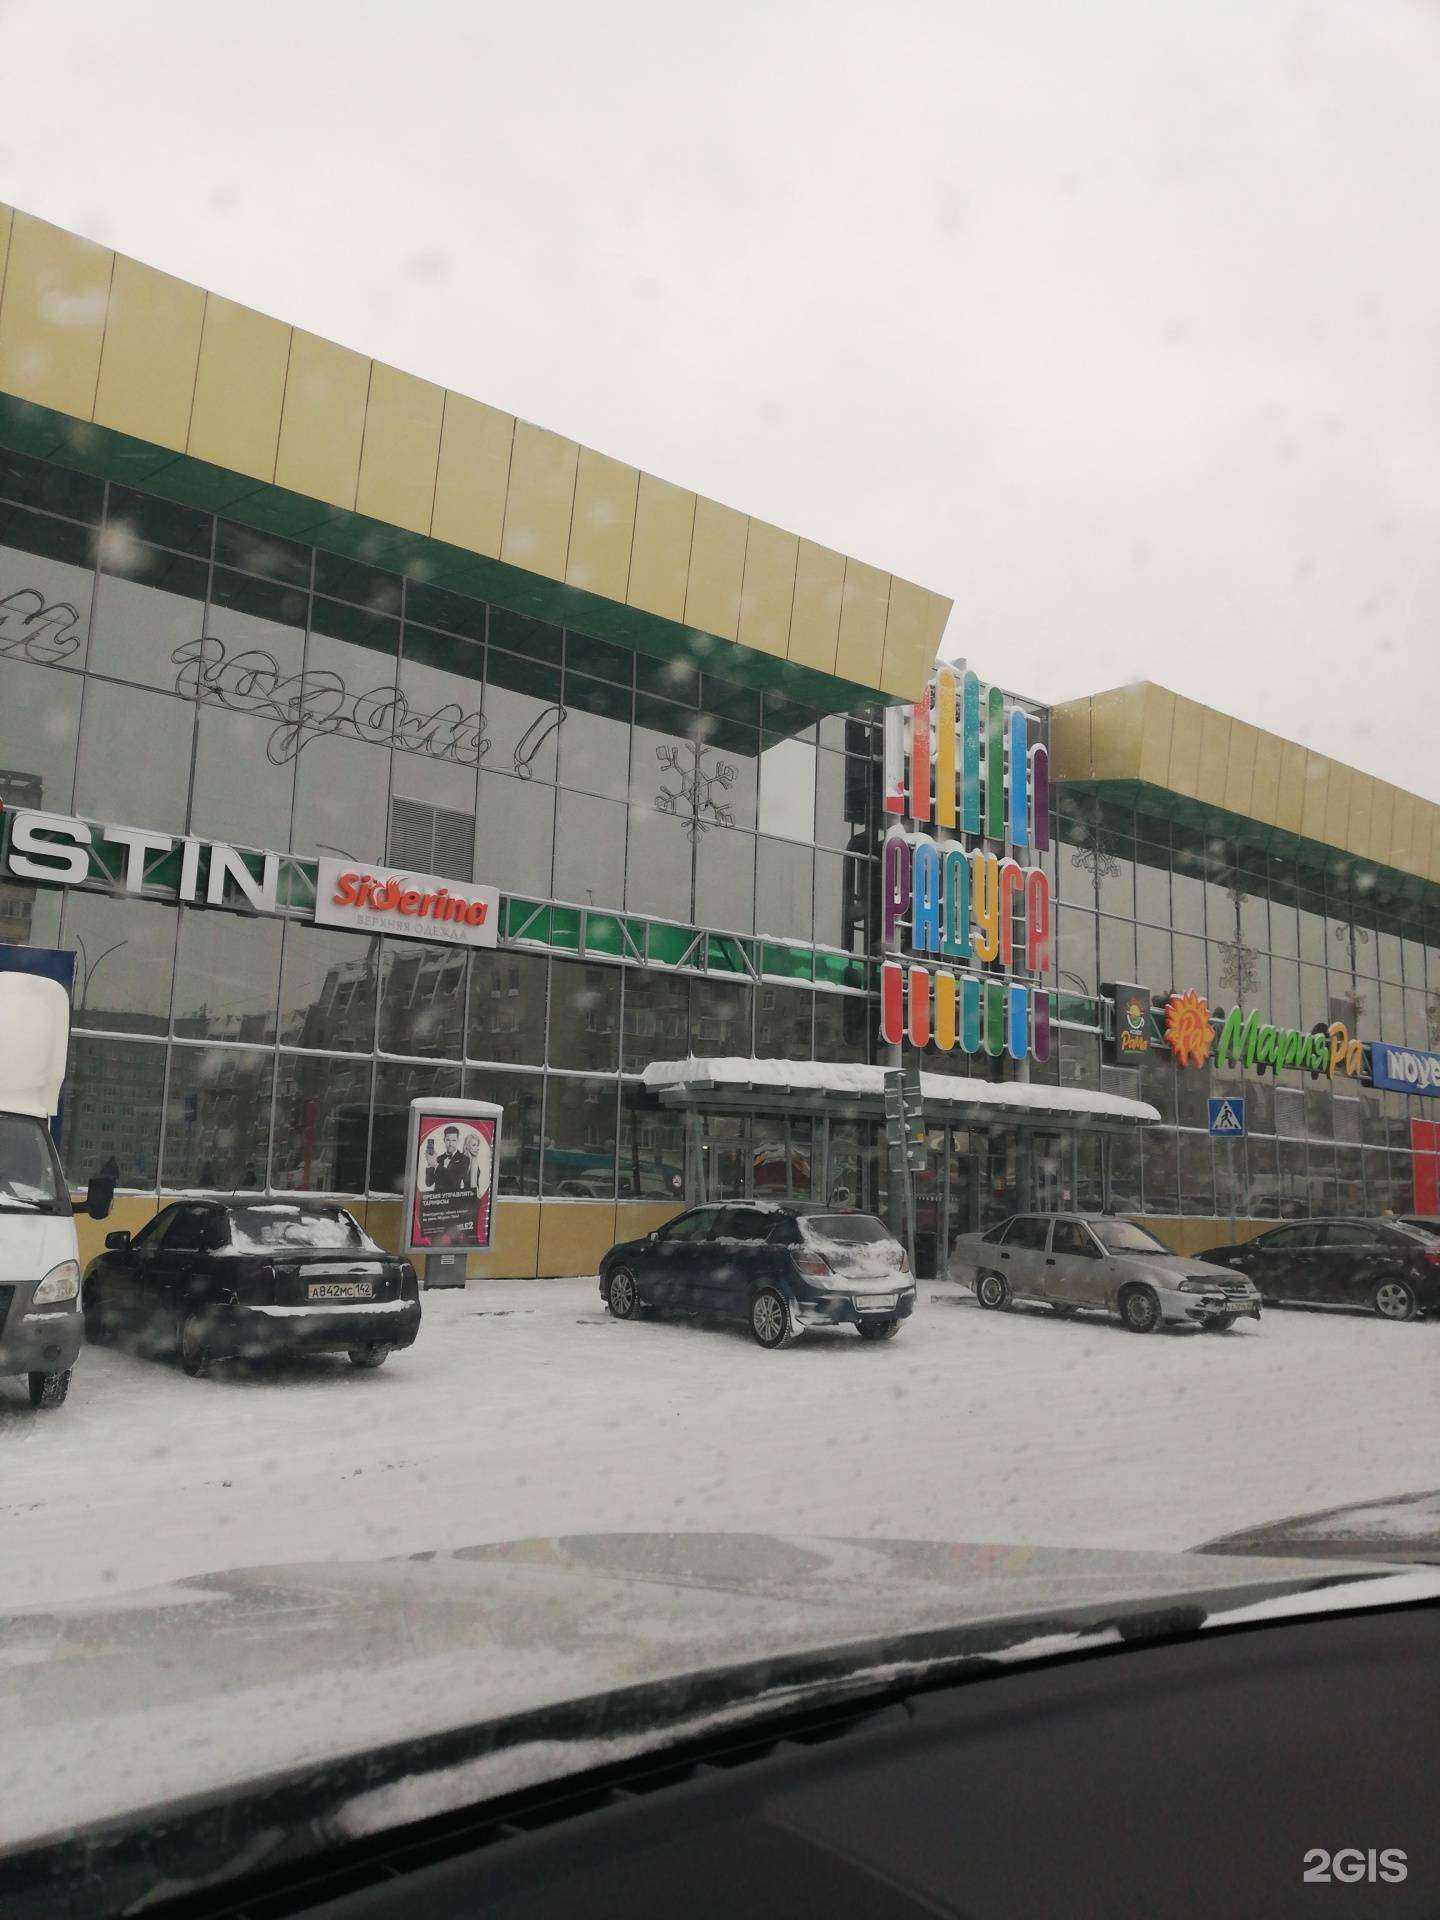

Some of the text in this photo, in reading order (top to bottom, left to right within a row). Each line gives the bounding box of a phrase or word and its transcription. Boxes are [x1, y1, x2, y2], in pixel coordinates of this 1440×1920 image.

[356, 914, 467, 940] ВЕРХНЯЯ ОДЕЖДА
[882, 836, 1049, 973] РАДУГА
